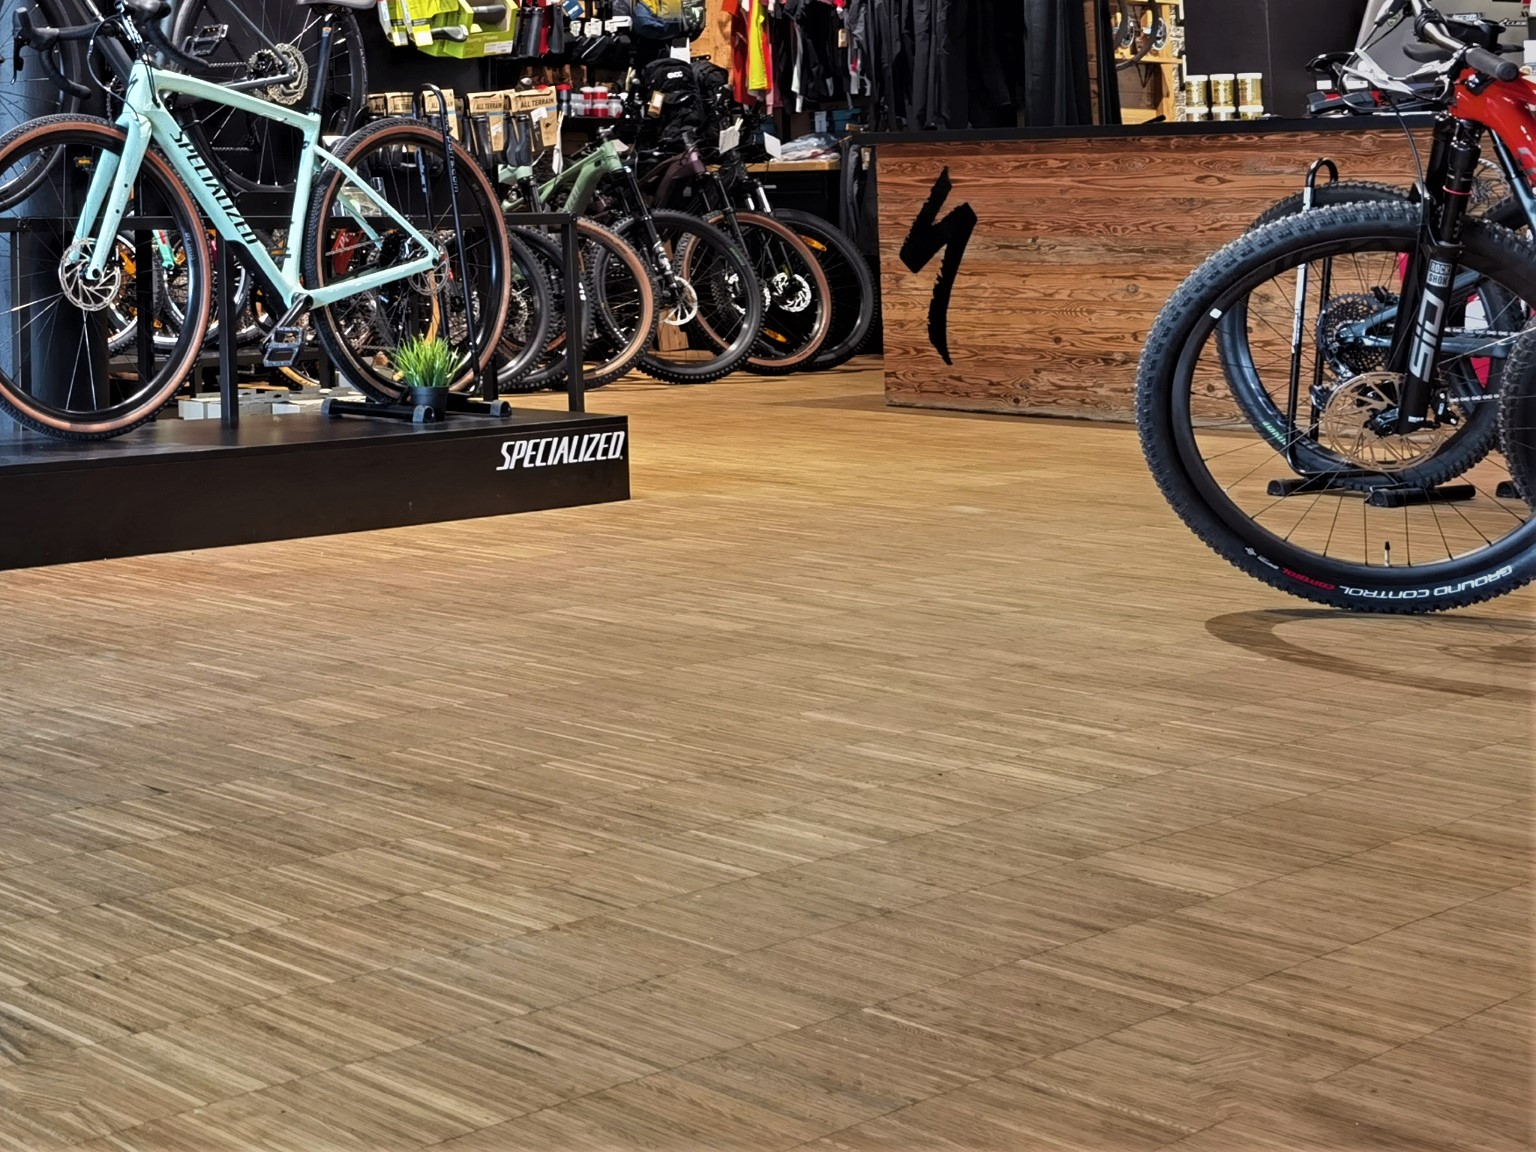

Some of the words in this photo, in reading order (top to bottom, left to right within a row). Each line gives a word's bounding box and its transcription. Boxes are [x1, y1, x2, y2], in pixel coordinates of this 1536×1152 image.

[532, 98, 554, 106] TERRAIN
[169, 130, 259, 245] SPECIALIZED
[1430, 261, 1451, 275] ROCK
[495, 430, 626, 471] SPECIALIZED
[1339, 584, 1429, 599] CONTROL
[1433, 564, 1513, 596] GROUND
